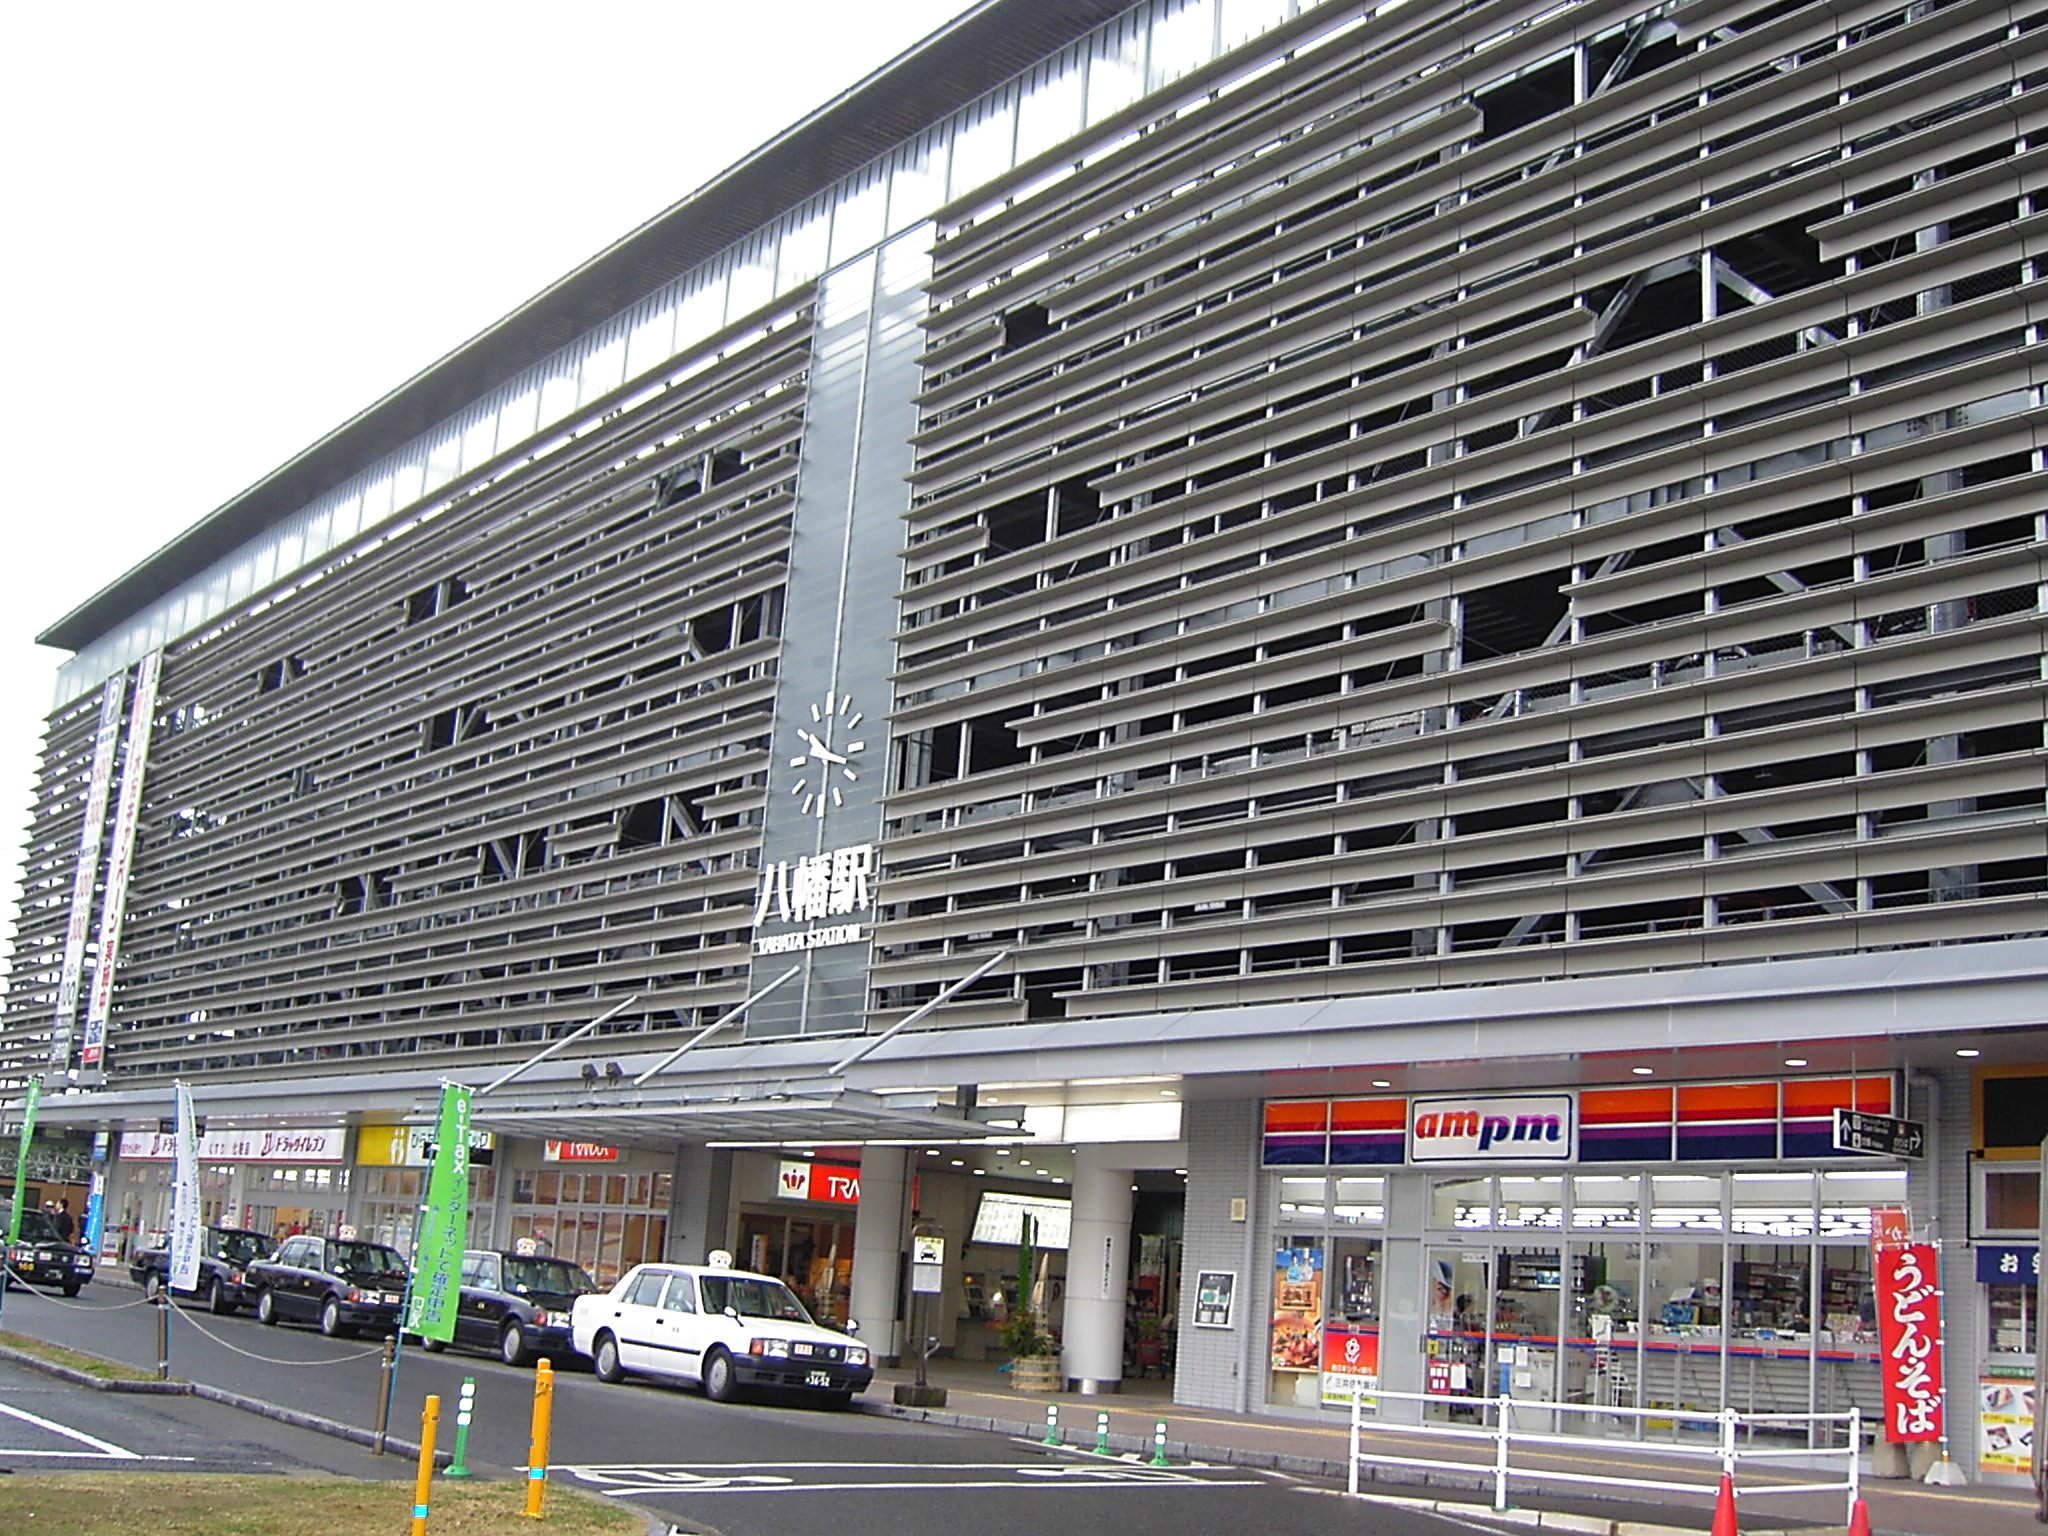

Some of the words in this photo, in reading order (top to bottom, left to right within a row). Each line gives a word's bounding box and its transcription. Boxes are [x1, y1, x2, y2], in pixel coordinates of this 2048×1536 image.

[754, 844, 872, 927] 八幡駅
[758, 931, 804, 955] YAHATA
[807, 923, 862, 949] STATION
[1415, 1110, 1562, 1151] ampm
[1892, 1253, 1942, 1434] うどんそば
